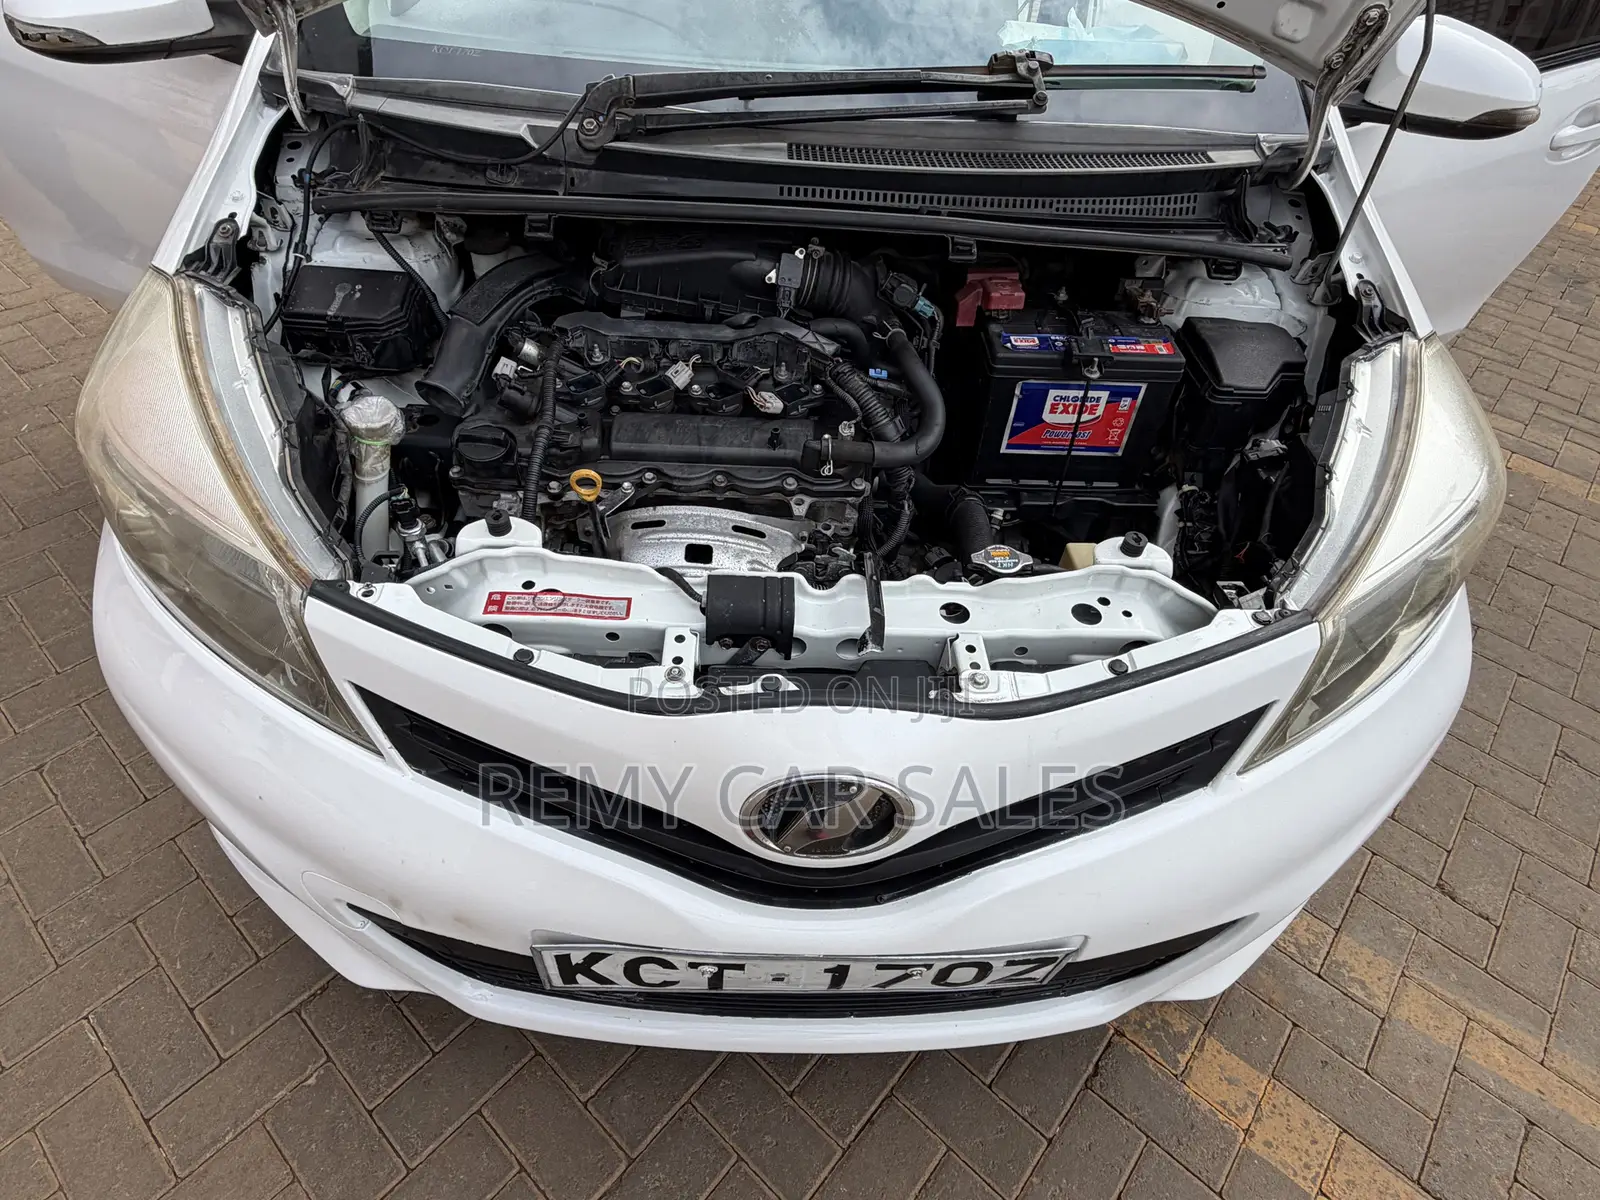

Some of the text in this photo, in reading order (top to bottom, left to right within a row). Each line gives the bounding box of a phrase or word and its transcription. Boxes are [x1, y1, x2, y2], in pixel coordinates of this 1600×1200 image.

[1053, 395, 1102, 403] CHLOIDE
[555, 952, 745, 991] KCT
[824, 955, 1061, 990] 170Z
